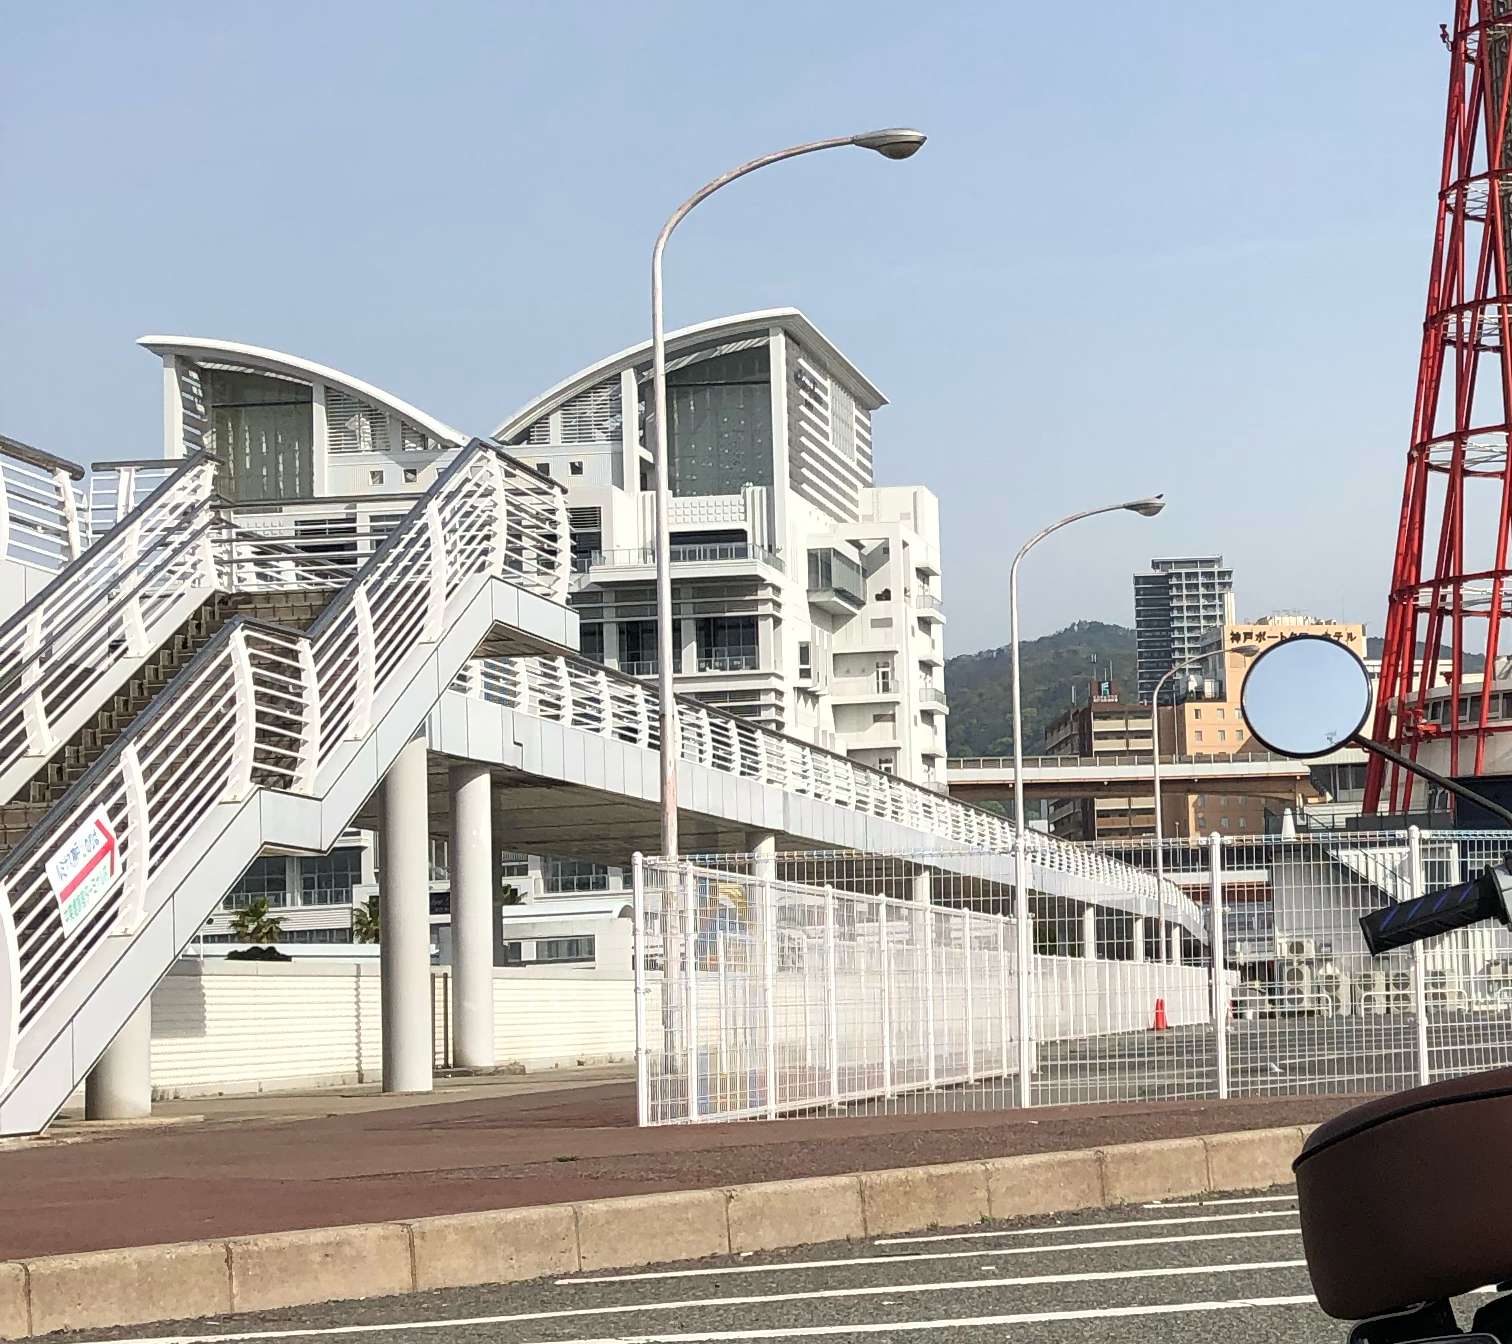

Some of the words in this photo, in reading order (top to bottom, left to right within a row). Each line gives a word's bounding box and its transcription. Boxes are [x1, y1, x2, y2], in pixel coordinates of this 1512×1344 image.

[1229, 630, 1357, 644] 神戸ポートタホテル
